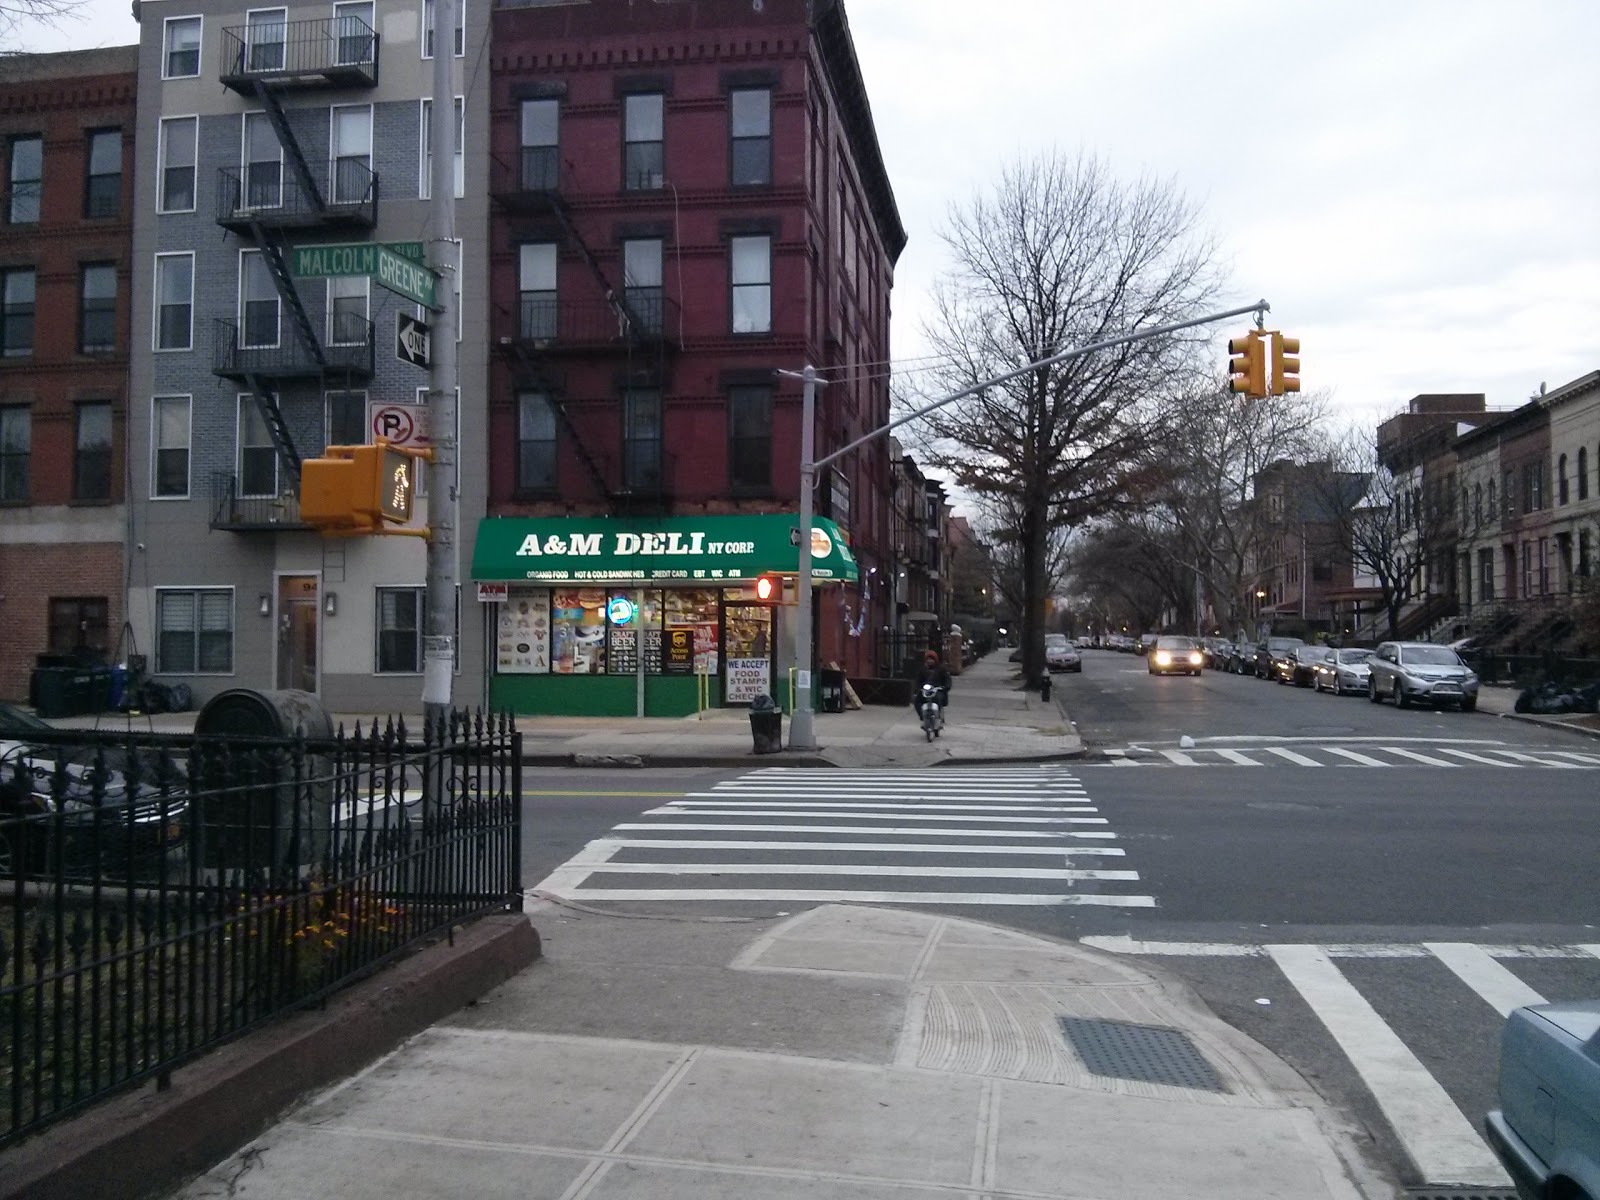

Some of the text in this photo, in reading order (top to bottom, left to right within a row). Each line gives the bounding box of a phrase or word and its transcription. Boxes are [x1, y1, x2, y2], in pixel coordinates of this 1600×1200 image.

[299, 247, 375, 275] MALCOLM
[379, 251, 424, 299] GREENE
[408, 332, 426, 355] ONE
[515, 531, 755, 556] A&M DELI NY CORP.
[552, 570, 569, 579] FOOD
[574, 570, 586, 579] HOT
[592, 570, 608, 579] COLD
[671, 569, 688, 578] CARD
[693, 569, 706, 578] EBT
[728, 569, 741, 578] ATM
[611, 637, 636, 647] BEER
[644, 637, 662, 647] EER
[728, 660, 769, 669] WE ACCEPT
[730, 677, 768, 685] STAMPS
